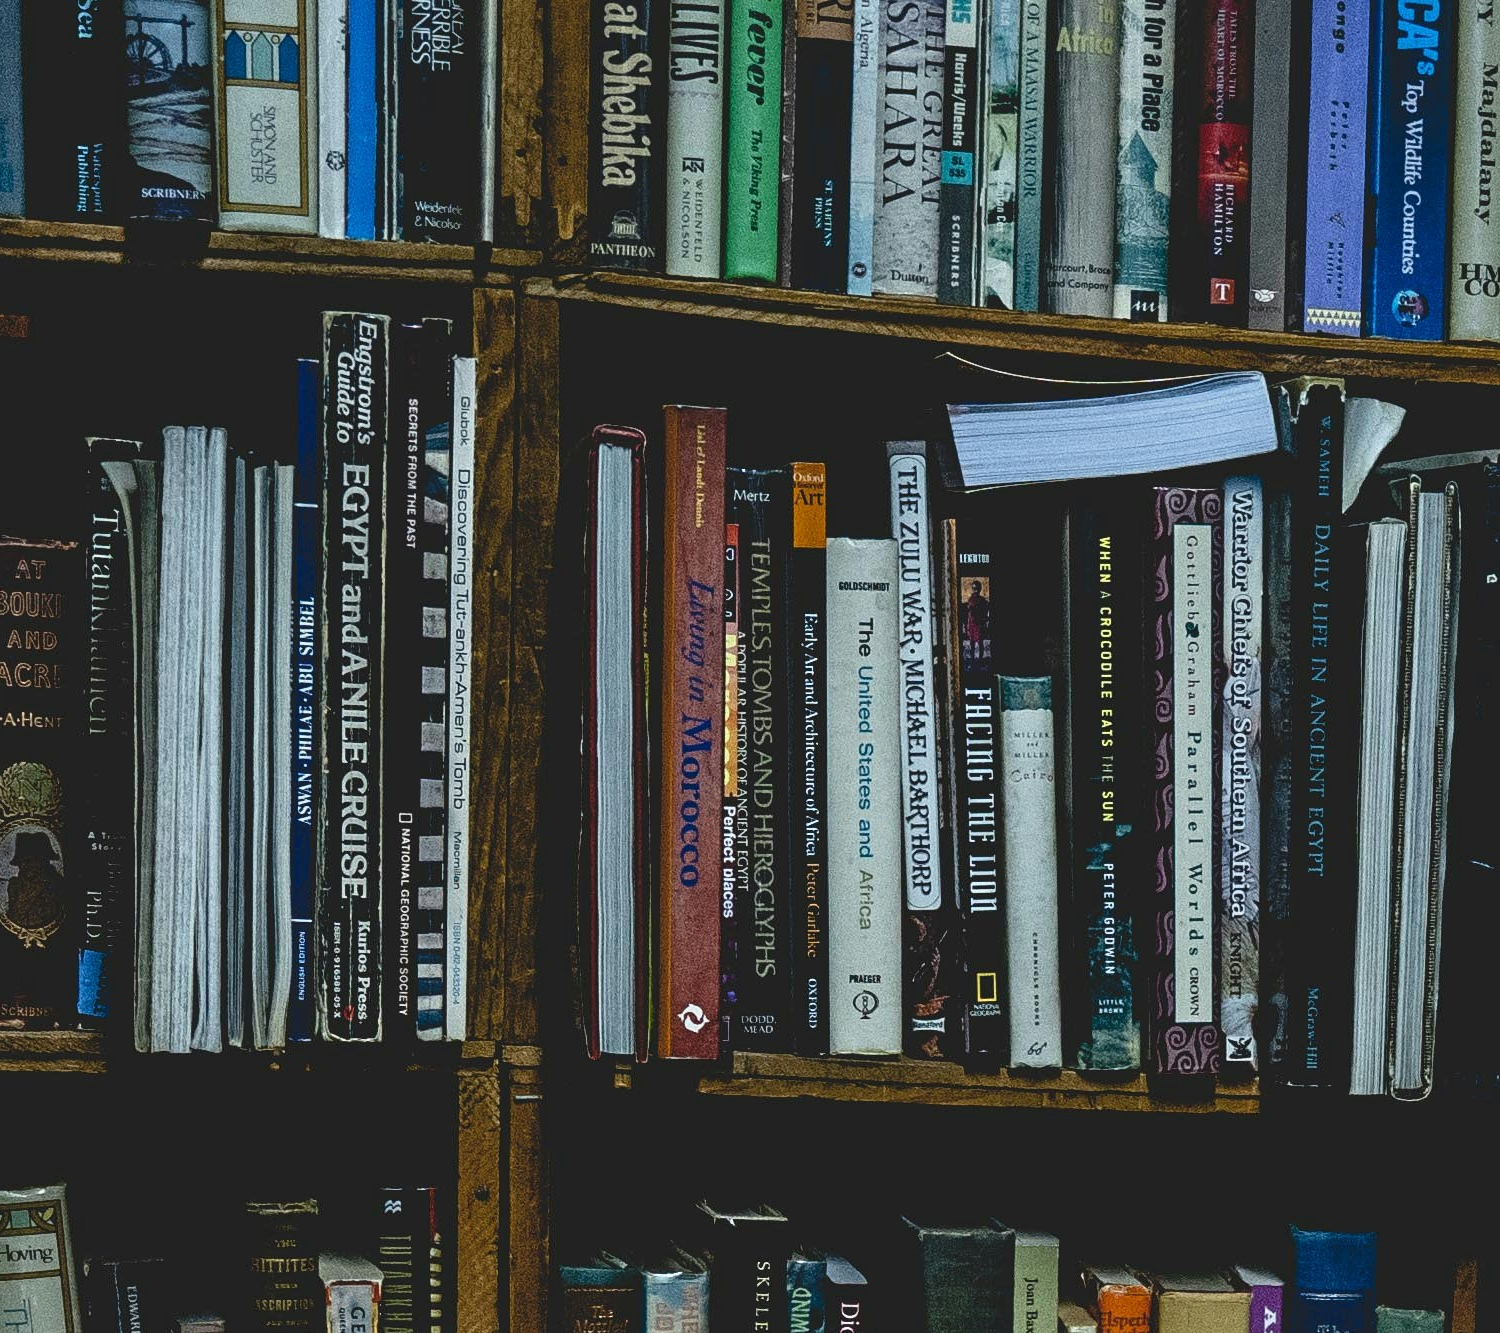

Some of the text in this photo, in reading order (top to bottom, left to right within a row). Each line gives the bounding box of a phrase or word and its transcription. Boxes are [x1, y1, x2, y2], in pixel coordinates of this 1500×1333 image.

[601, 51, 652, 190] Shebika
[747, 10, 774, 107] fever
[883, 8, 921, 208] SAHARA
[952, 52, 968, 148] Harris/Weeks
[141, 186, 206, 202] SCRIBNERS
[921, 90, 944, 207] GREAT
[1401, 80, 1425, 276] Top Wildlife Countries
[1477, 62, 1498, 228] Majdalany
[590, 242, 655, 258] PANTHEON
[336, 350, 355, 413] Guide
[357, 320, 377, 445] Engstrom's
[732, 487, 771, 504] Mertz
[339, 462, 370, 902] EGYPT and A NILE CRUISE
[453, 757, 470, 810] Tomb
[678, 712, 713, 888] Morocco
[750, 537, 777, 978] TEMPLES, TOMBS AND HIEROGLYPHS
[857, 617, 874, 932] The United States and Africa
[902, 657, 933, 897] MICHAEL BARTHORP
[964, 687, 998, 915] FACING THE LION
